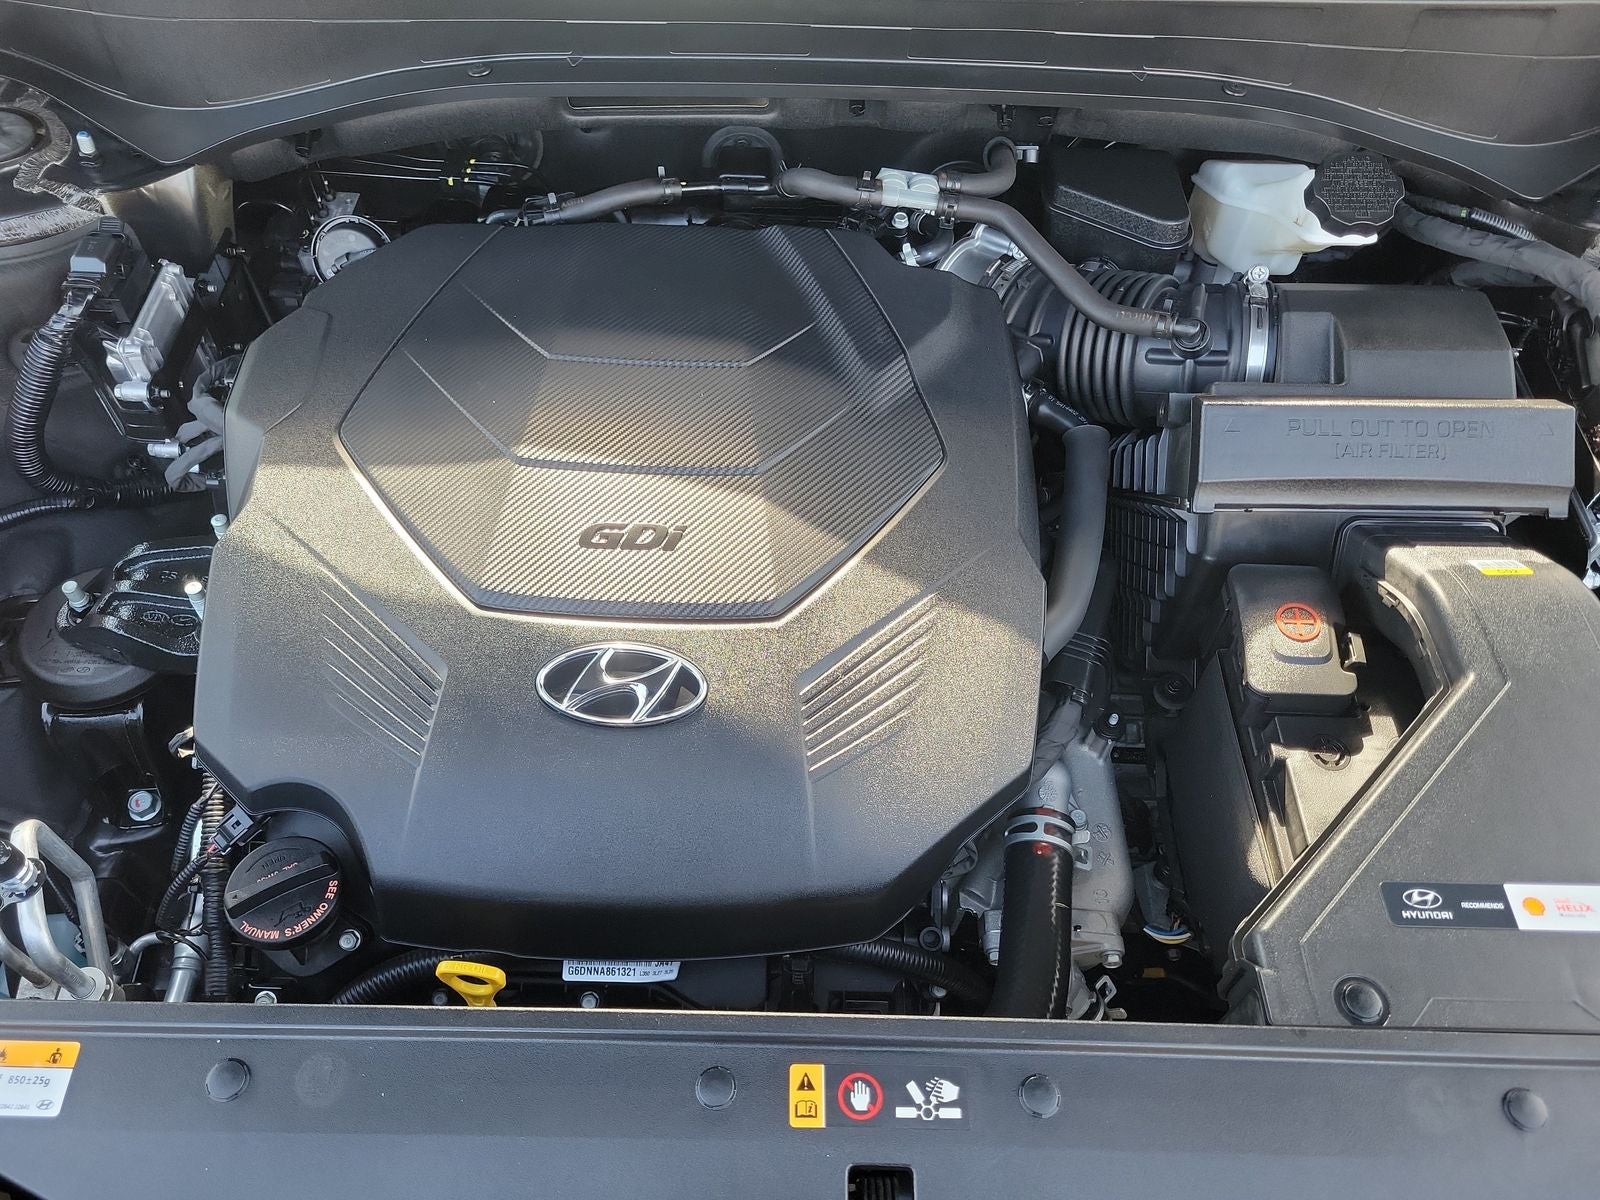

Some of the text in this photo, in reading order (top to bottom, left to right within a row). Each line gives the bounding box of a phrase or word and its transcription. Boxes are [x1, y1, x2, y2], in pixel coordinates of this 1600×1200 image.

[1286, 418, 1493, 439] PULL OUT TO OPEN
[579, 522, 688, 552] GDi
[239, 880, 338, 940] SEE OWNER'S MANUAL
[1402, 901, 1504, 920] HYUNDAI RECOMMENDS
[567, 966, 636, 977] G6DNNA861321
[8, 1075, 50, 1088] 850±25g
